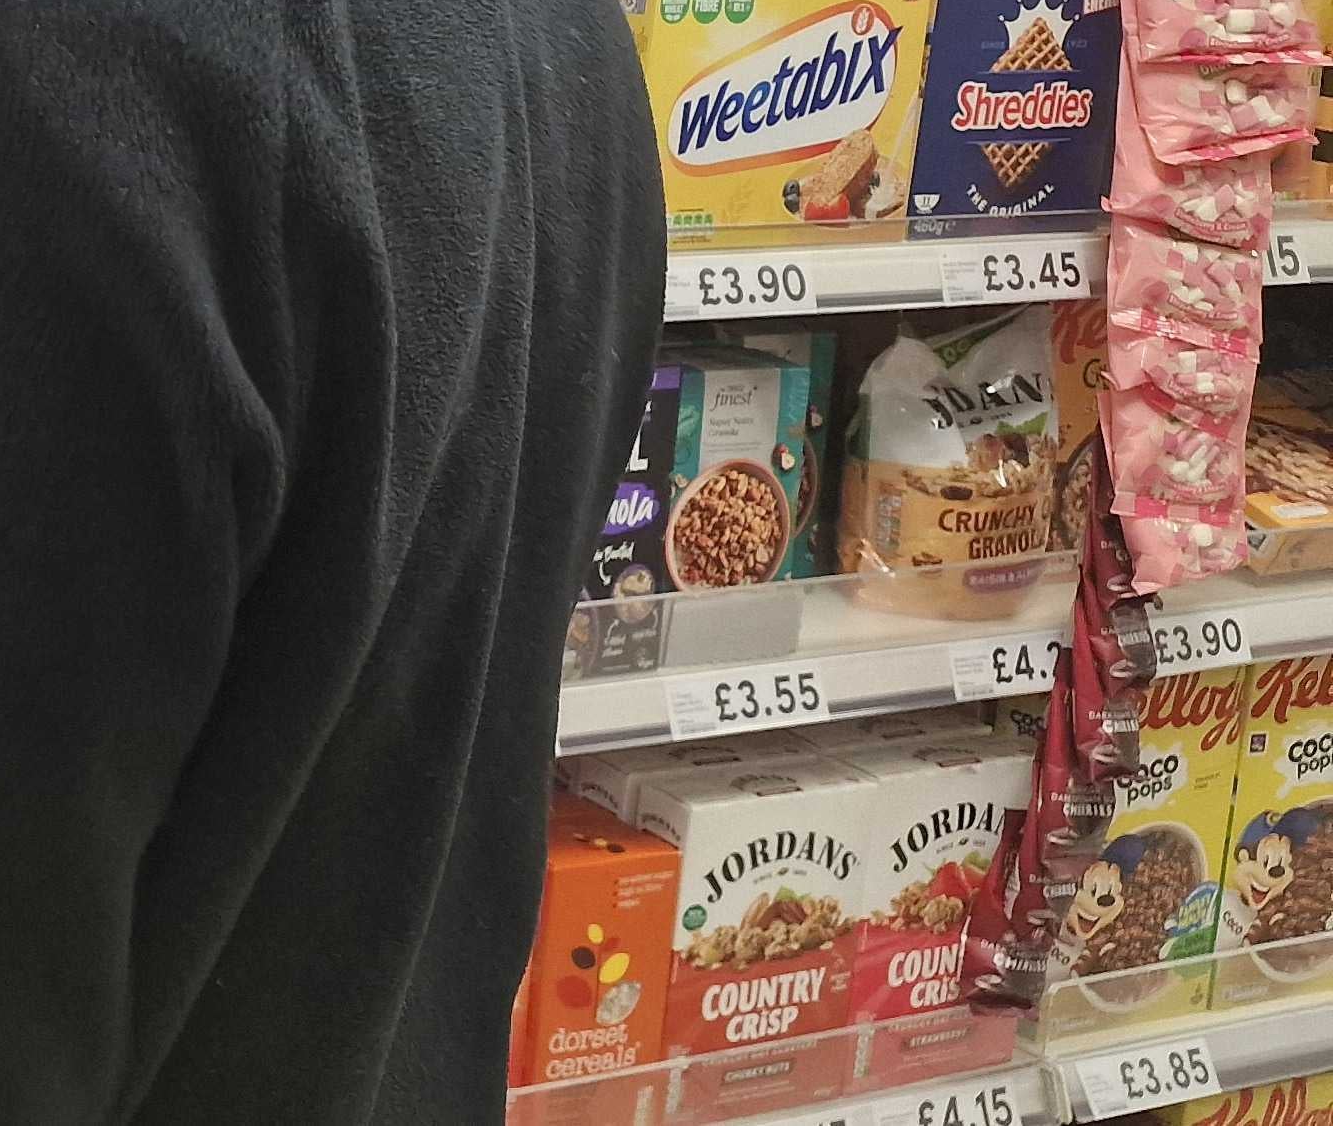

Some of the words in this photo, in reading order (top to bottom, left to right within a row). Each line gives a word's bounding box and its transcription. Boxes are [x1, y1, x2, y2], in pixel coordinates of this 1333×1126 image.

[678, 26, 904, 155] Weetabix
[950, 80, 1093, 130] Shreddies
[699, 264, 806, 304] £3.90
[983, 251, 1080, 290] £3.45
[939, 506, 1039, 533] CRUNCHY
[1155, 619, 1241, 663] £3.90
[714, 674, 819, 722] £3.55
[702, 830, 858, 902] JORDANS
[702, 967, 826, 1020] COUNTRY
[546, 1041, 640, 1077] cereals
[548, 1024, 629, 1054] dorset
[1121, 1048, 1209, 1097] £3.85
